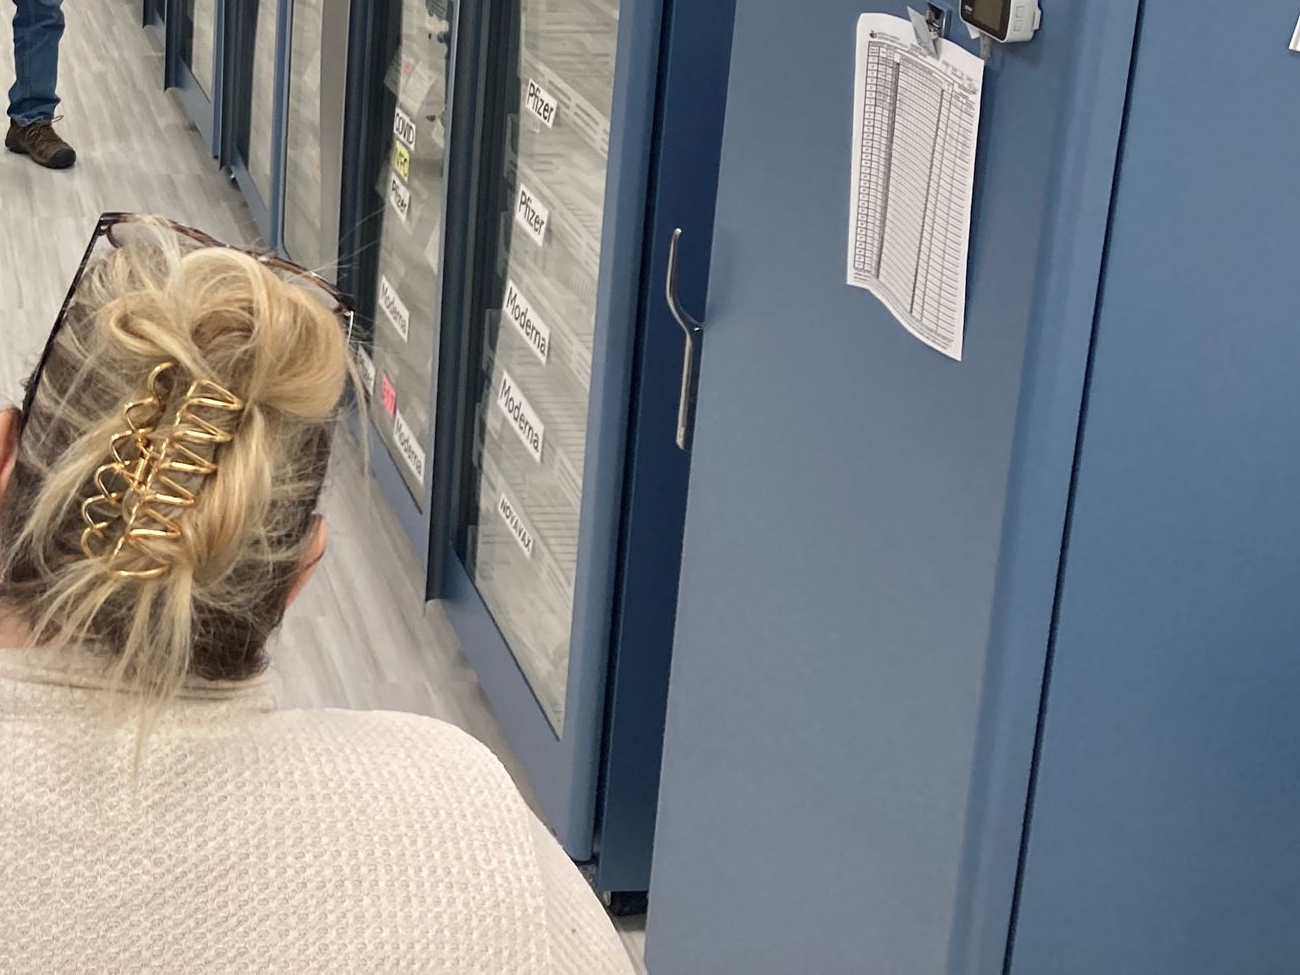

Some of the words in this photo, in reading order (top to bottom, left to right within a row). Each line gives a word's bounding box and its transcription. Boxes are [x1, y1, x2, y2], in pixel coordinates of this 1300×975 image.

[527, 82, 554, 124] Pfizer
[395, 112, 415, 145] COVID
[519, 191, 545, 235] Pfizer
[506, 286, 547, 353] Moderna
[501, 377, 540, 453] Moderna
[501, 496, 532, 553] NOVAVAX
